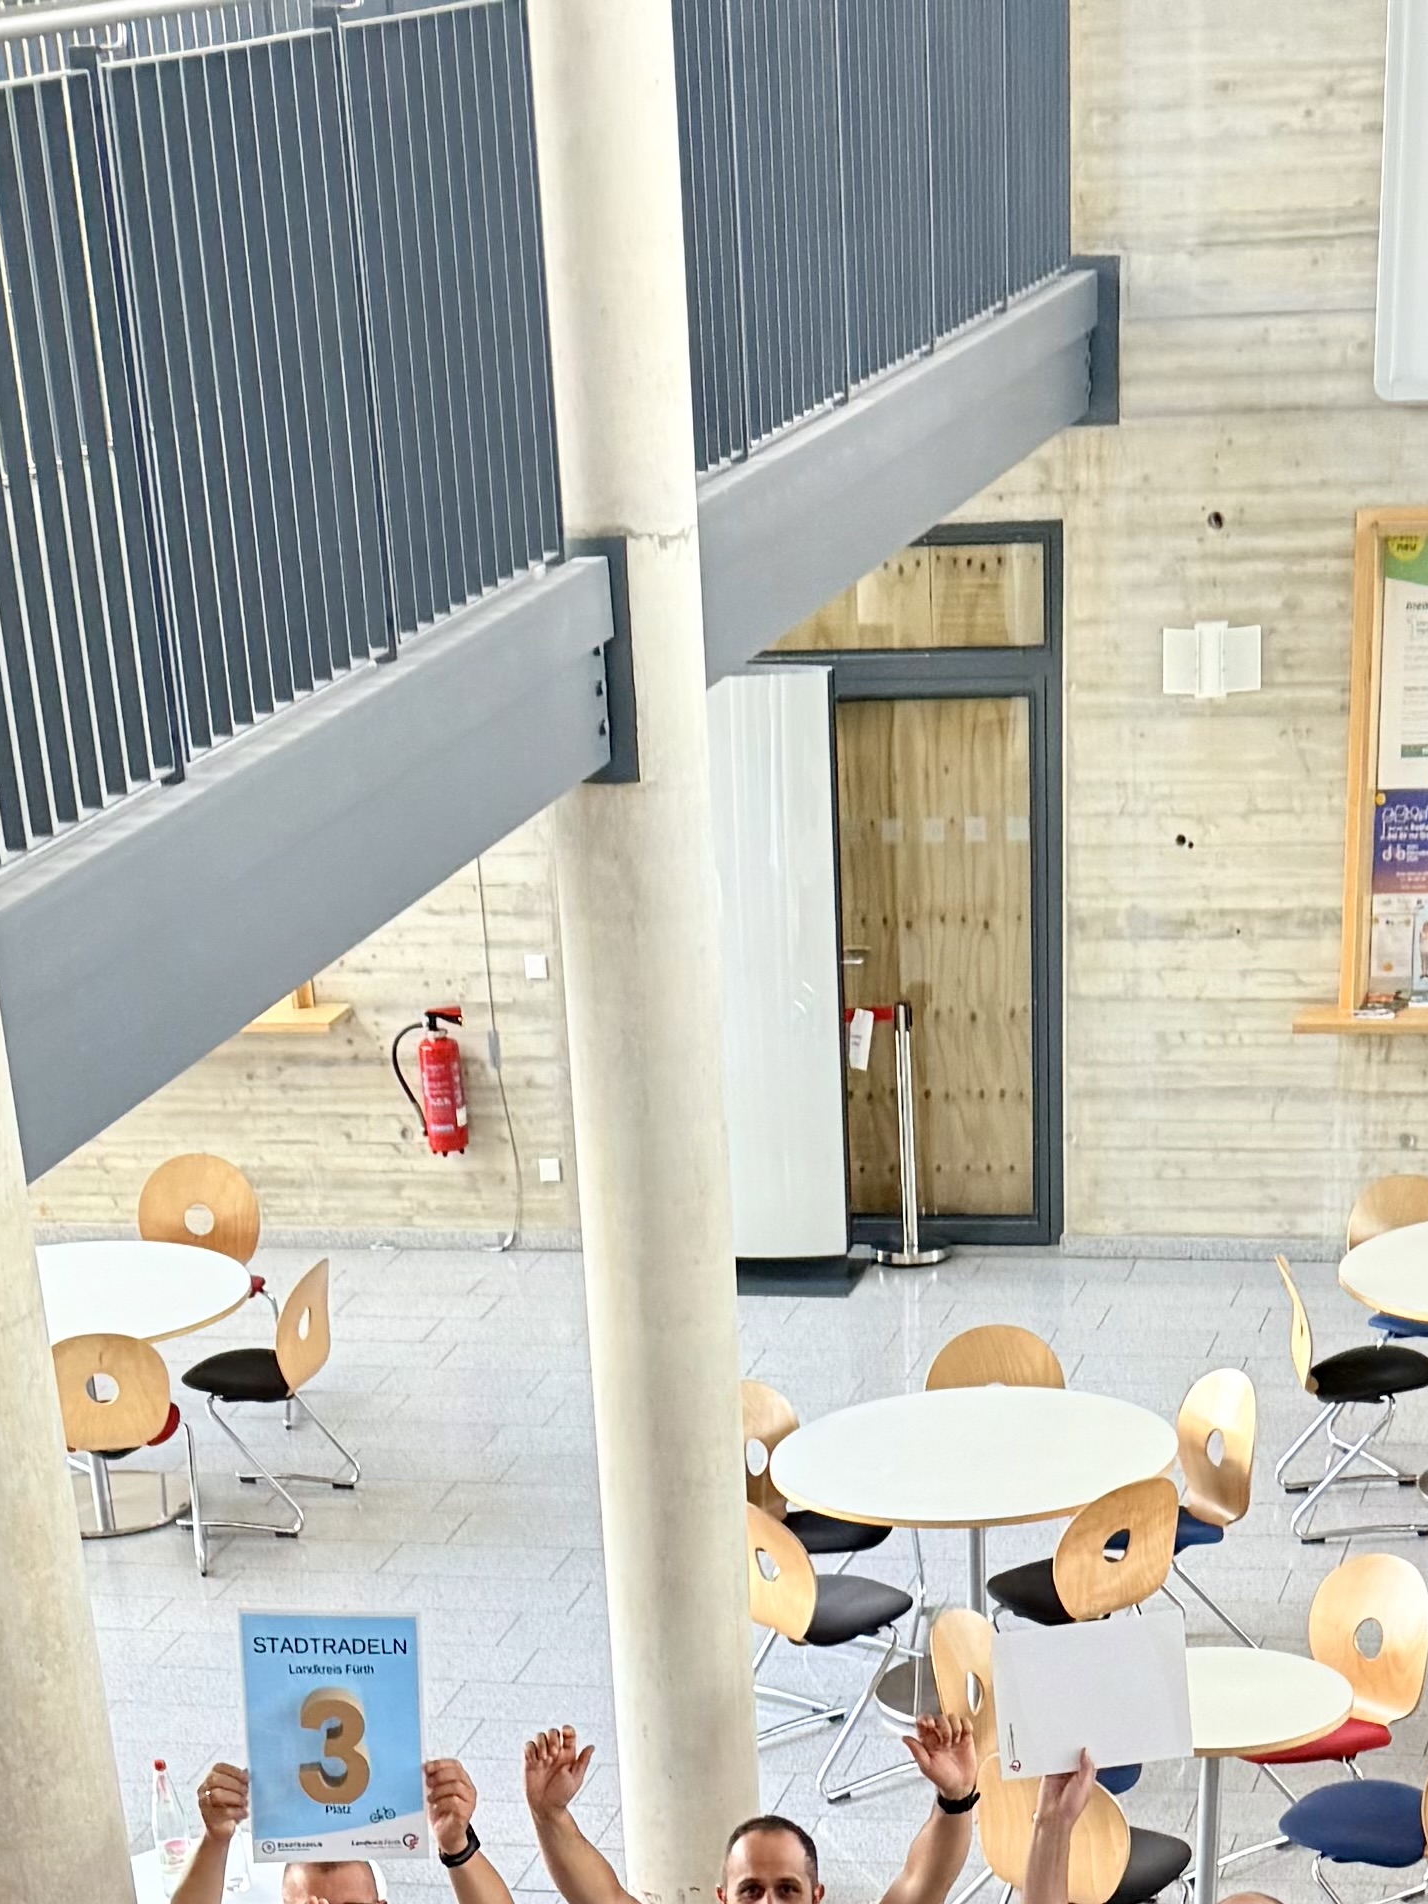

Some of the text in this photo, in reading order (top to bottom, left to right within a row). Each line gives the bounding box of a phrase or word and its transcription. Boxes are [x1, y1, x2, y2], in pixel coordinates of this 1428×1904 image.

[253, 1636, 408, 1655] STADTRADELN
[288, 1662, 375, 1675] Landkreis Fürth
[298, 1686, 370, 1804] 3
